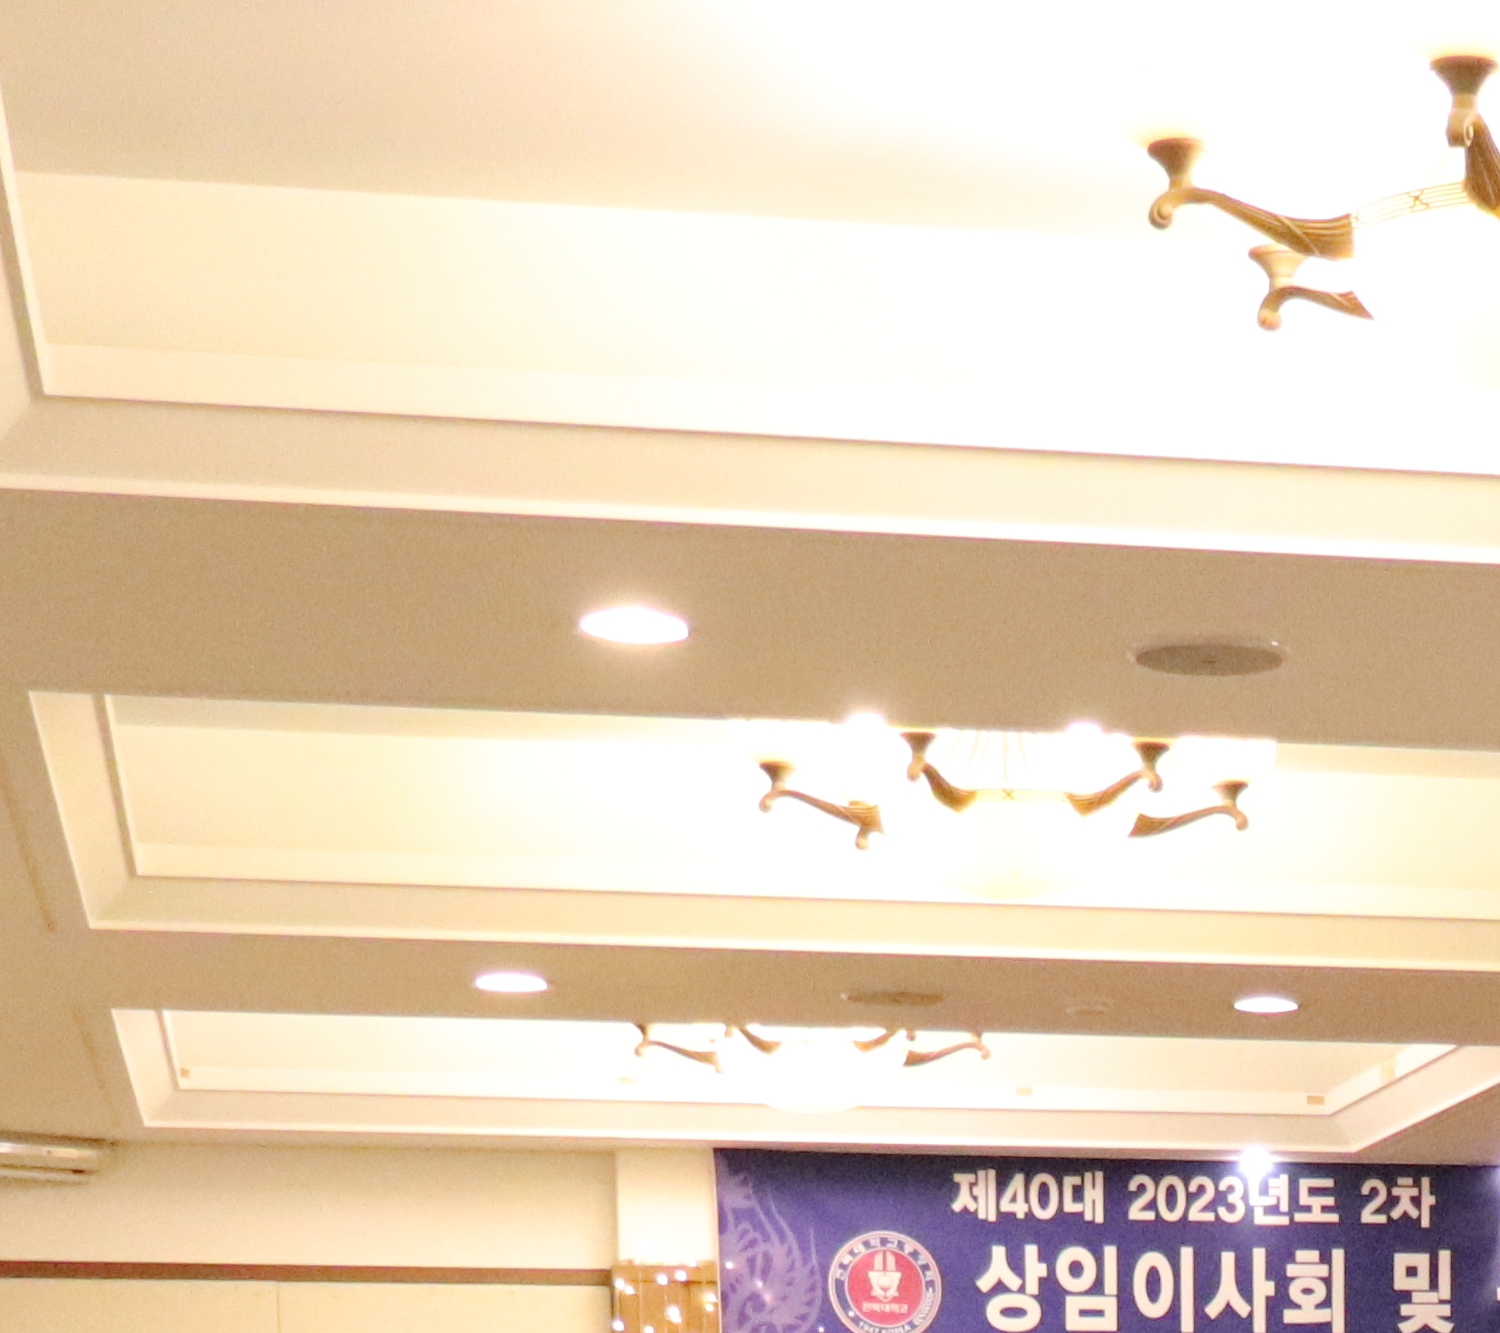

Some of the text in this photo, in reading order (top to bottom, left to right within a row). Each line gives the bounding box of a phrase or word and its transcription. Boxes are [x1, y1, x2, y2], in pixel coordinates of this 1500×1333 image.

[950, 1170, 1436, 1228] 제40대 2023년도 2차
